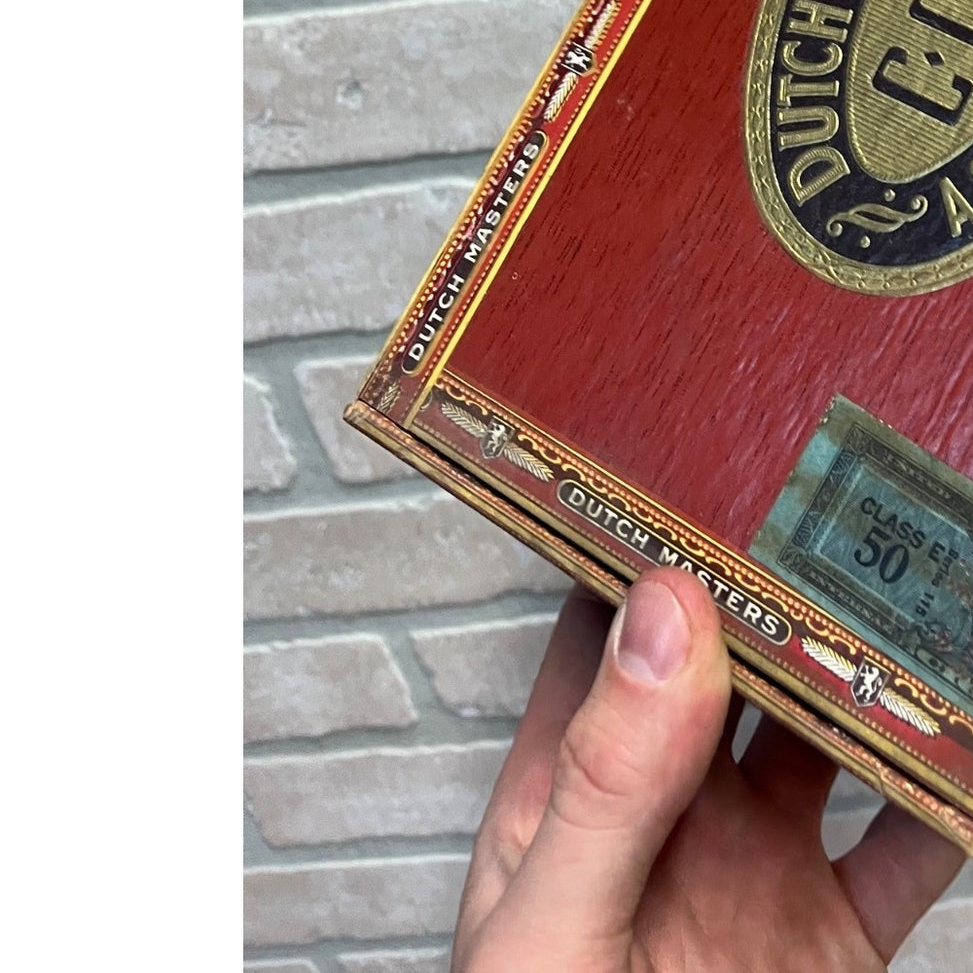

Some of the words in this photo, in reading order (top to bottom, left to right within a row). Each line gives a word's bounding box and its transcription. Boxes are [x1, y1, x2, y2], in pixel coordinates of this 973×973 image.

[408, 276, 465, 361] DUTCH
[464, 142, 539, 263] MASTERS
[568, 487, 649, 549] DUTCH
[861, 497, 926, 548] CLASS
[927, 541, 945, 564] E
[854, 526, 909, 583] 50
